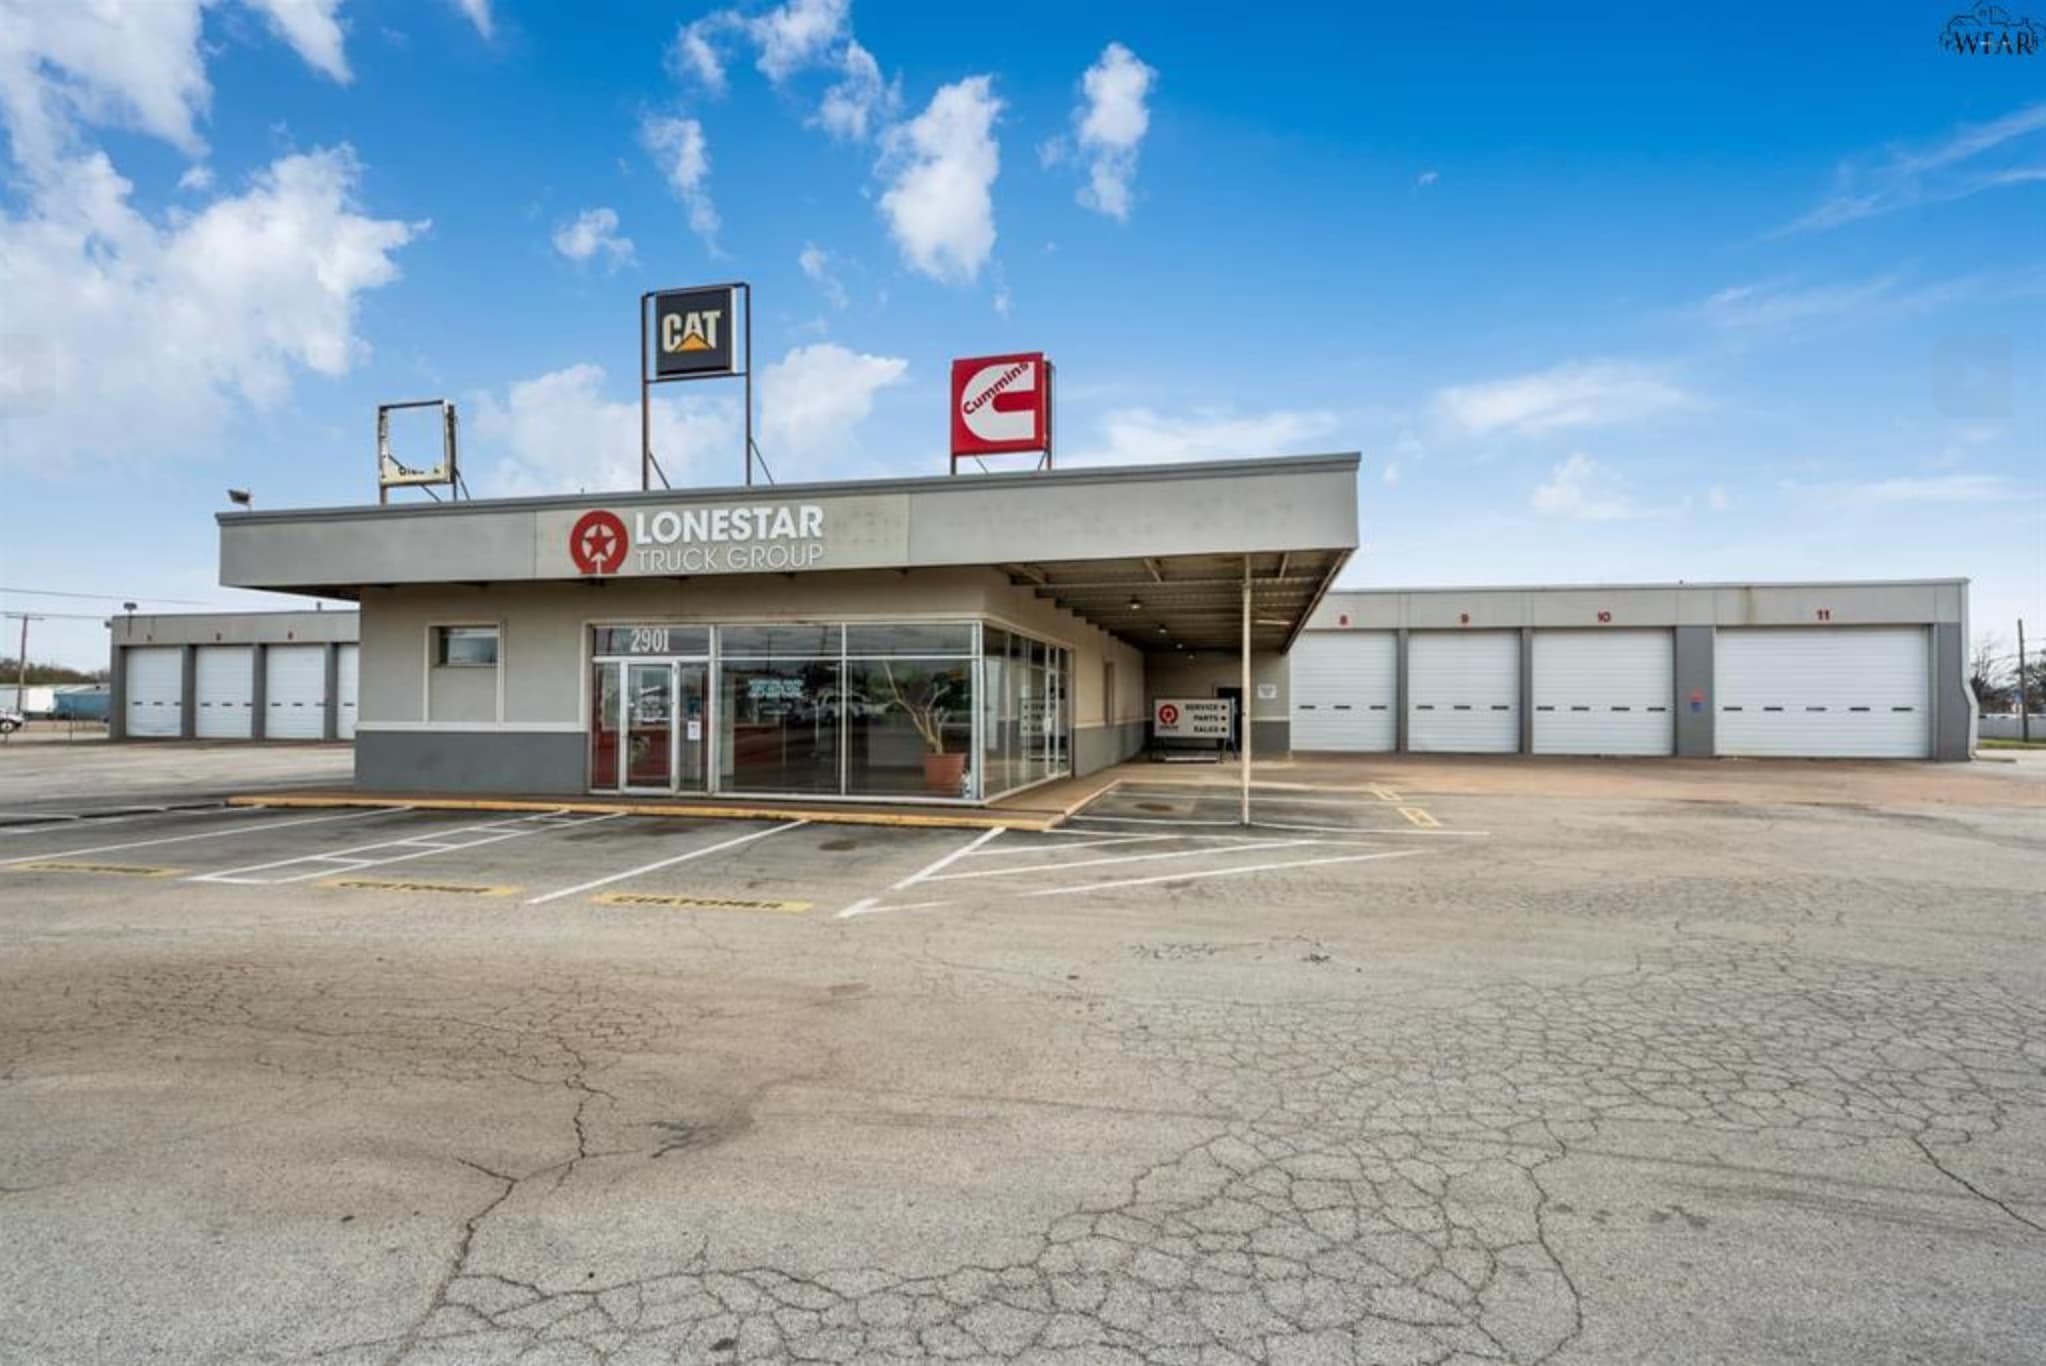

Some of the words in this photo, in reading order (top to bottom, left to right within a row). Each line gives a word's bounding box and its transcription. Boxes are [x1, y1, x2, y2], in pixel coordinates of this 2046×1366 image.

[662, 309, 721, 353] CAT
[963, 363, 1029, 415] Cummins
[635, 505, 824, 545] LONESTAR
[637, 546, 719, 573] TRUCK
[727, 543, 824, 570] GROUP
[1597, 611, 1611, 623] 10
[1816, 609, 1831, 621] 11
[630, 629, 670, 653] 2901
[1185, 703, 1218, 711] SERVICE
[1193, 714, 1218, 722] PARTS
[1193, 725, 1218, 733] SALES
